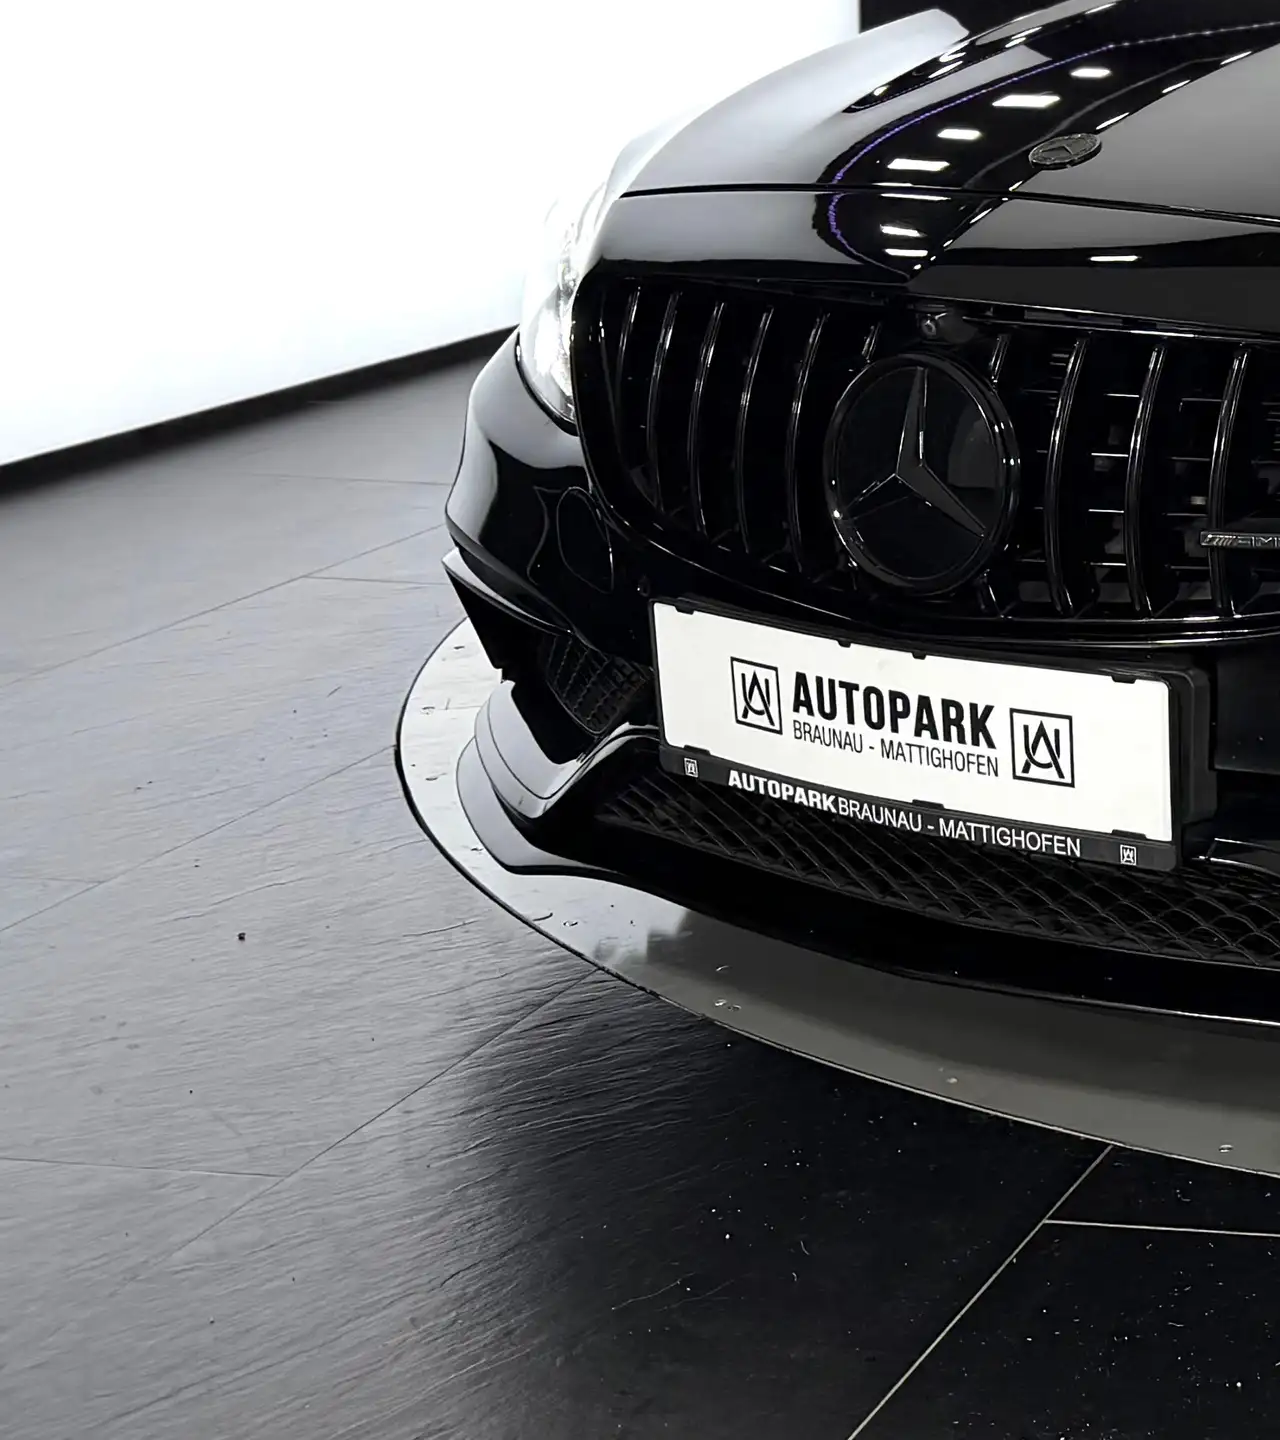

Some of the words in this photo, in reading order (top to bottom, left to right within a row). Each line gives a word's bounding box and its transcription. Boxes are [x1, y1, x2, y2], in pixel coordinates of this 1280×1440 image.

[791, 671, 997, 750] AUTOPARK
[793, 720, 864, 754] BRAUNAU
[880, 740, 999, 777] MATTIGHOFEN
[939, 817, 1082, 858] MATTIGHOFEN
